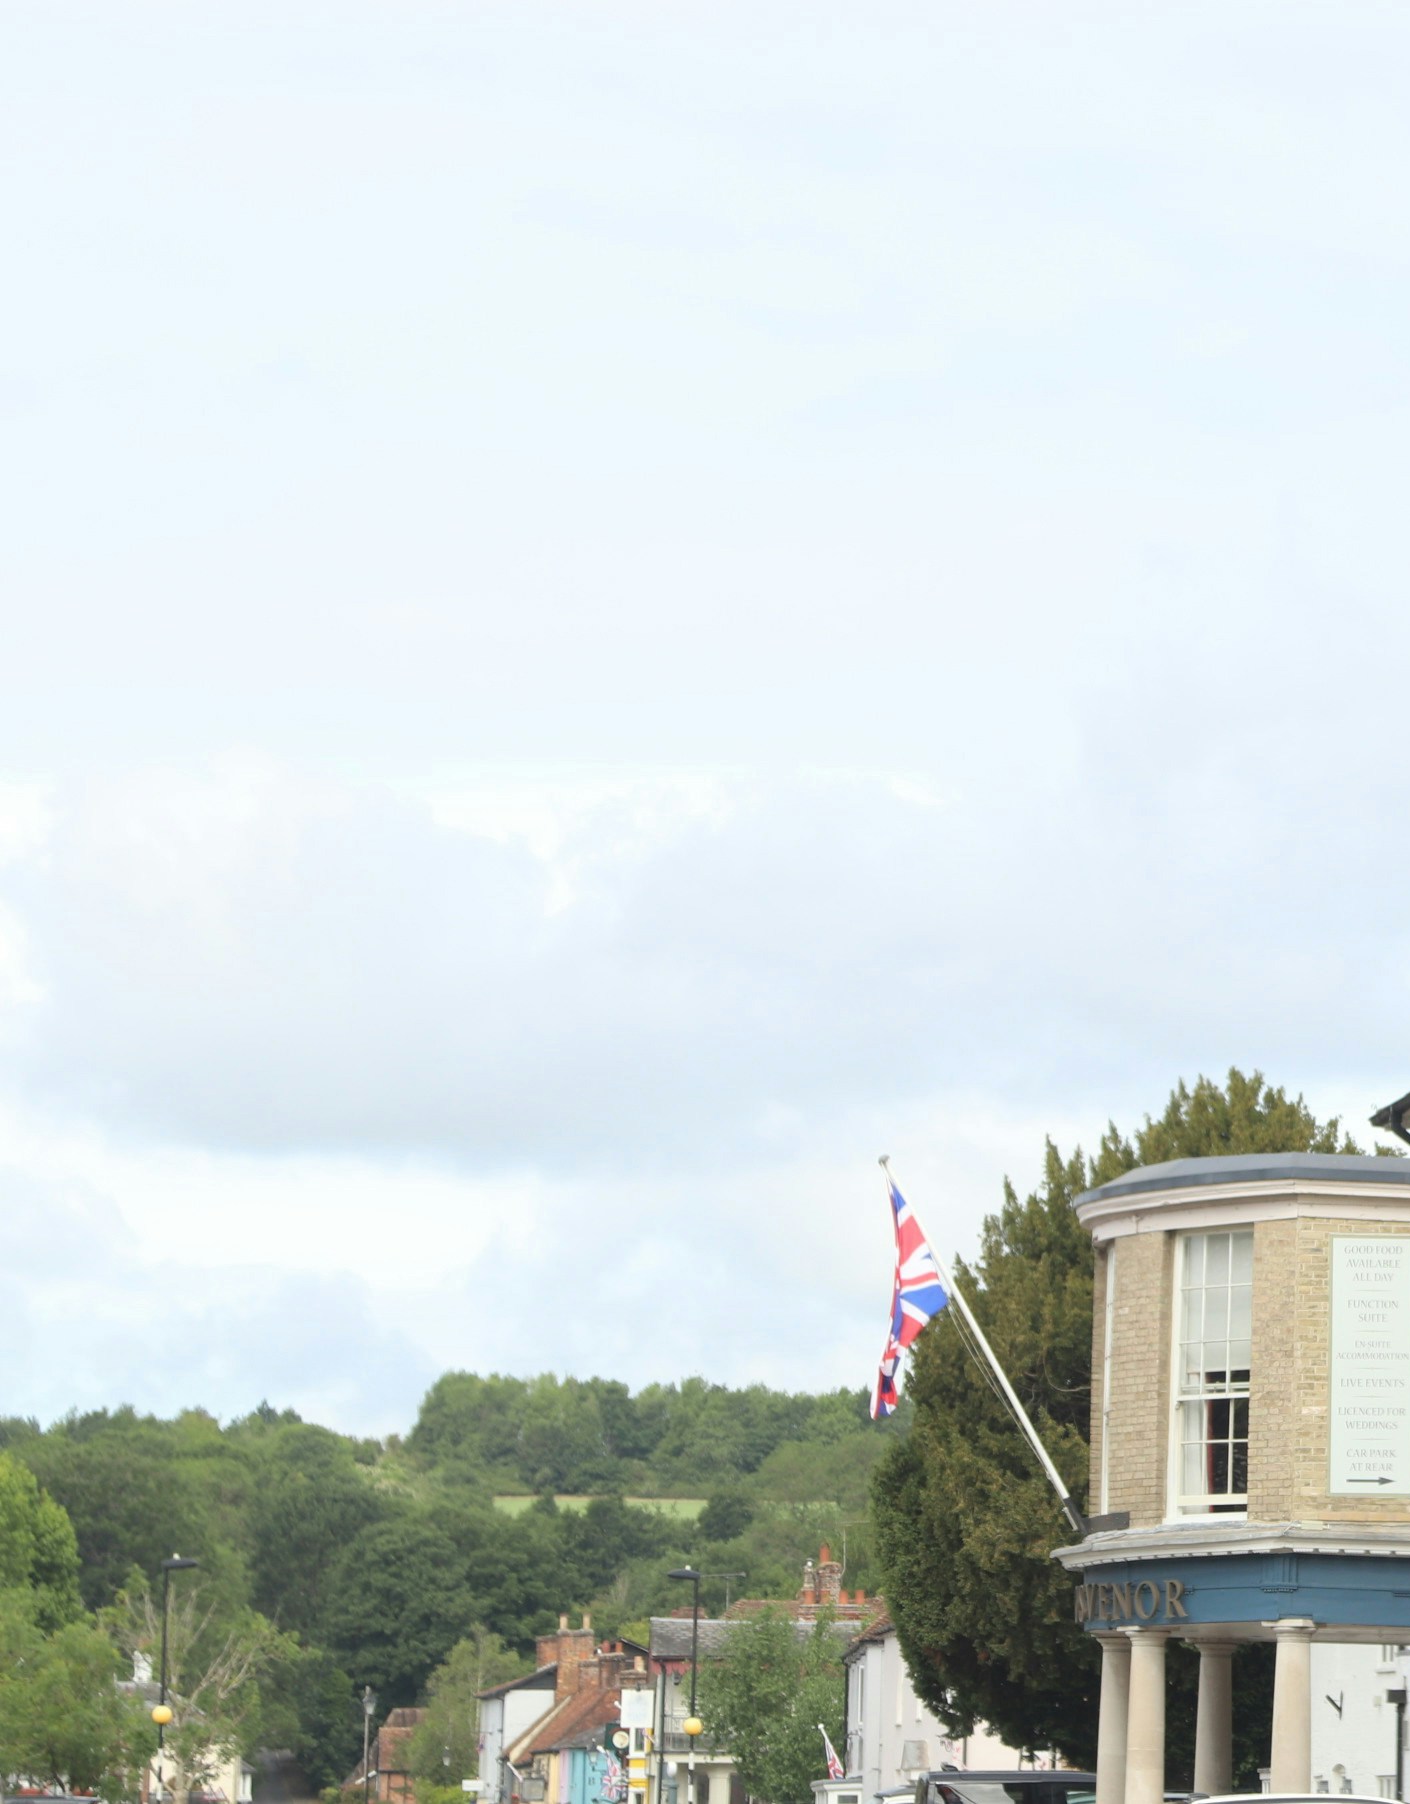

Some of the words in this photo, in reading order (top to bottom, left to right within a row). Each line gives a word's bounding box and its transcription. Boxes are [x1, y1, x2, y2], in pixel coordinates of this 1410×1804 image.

[1344, 1245, 1373, 1255] GOOD
[1375, 1245, 1403, 1255] FOOD
[1346, 1259, 1401, 1269] AVAILABLE
[1352, 1272, 1372, 1282] ALL
[1374, 1272, 1394, 1282] DAY
[1347, 1299, 1400, 1309] FUNCTION
[1358, 1313, 1388, 1323] SUITE
[1336, 1351, 1410, 1361] ACCOMMODATION
[1340, 1378, 1363, 1388] LIVE
[1365, 1378, 1405, 1388] EVENTS
[1387, 1406, 1407, 1417] FOR
[1345, 1420, 1399, 1430] WEDDINGS
[1346, 1448, 1367, 1458] CAR
[1369, 1448, 1397, 1458] PARK
[1350, 1462, 1364, 1472] AT
[1365, 1462, 1393, 1472] REAR
